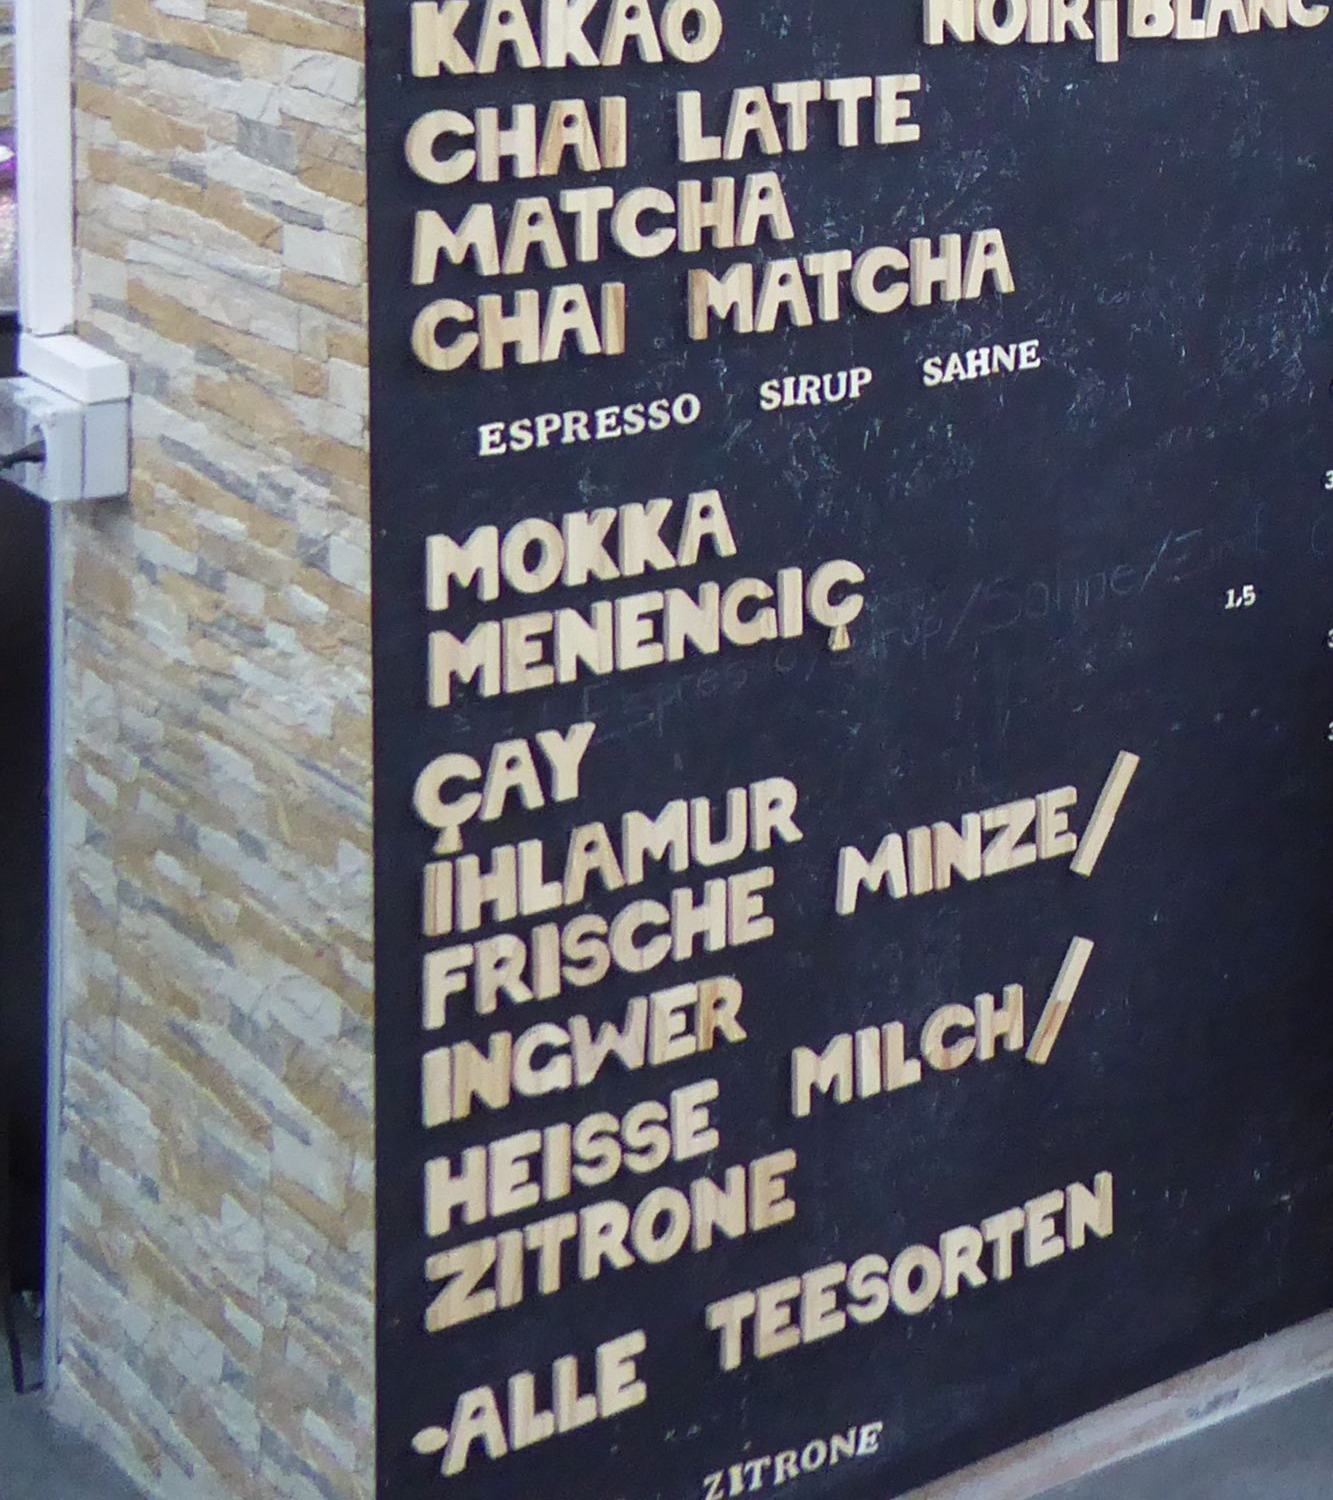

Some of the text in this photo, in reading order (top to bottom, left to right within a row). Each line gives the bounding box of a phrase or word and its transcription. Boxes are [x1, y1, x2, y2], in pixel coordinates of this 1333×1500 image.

[405, 73, 921, 184] CHAI LATTE
[412, 171, 794, 285] MATCHA
[412, 228, 1015, 370] CHAI MATCHA
[477, 338, 1043, 458] ESPRESSO SIRUP SAHNE
[426, 489, 736, 611] MOKKA
[1224, 584, 1257, 610] 1,5
[428, 560, 865, 707] MENENGIÇ
[413, 721, 596, 854] ÇAY
[423, 866, 775, 1030] FRISCHE
[422, 975, 746, 1127] INGWER
[425, 1079, 719, 1236] HEISSE
[426, 1149, 796, 1331] ZITRONE
[707, 1171, 1112, 1370] TEESORTEN
[703, 1420, 884, 1499] ZITRONE
